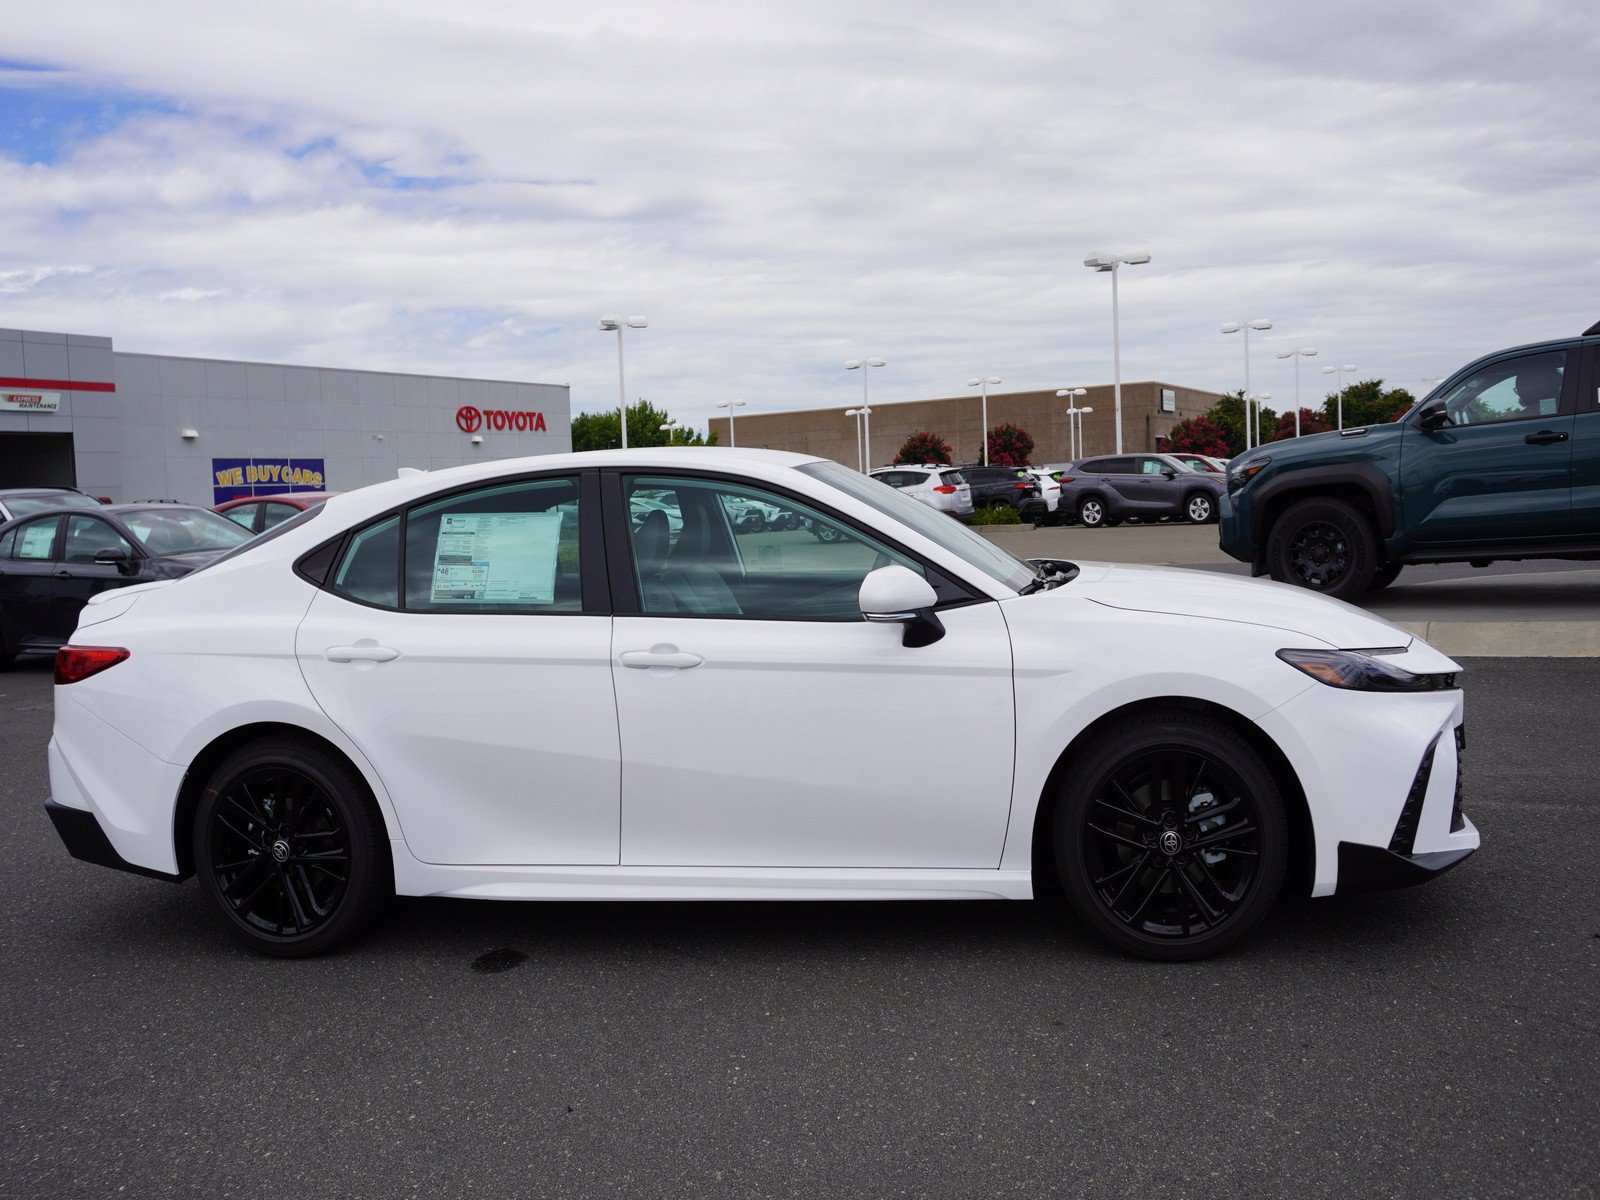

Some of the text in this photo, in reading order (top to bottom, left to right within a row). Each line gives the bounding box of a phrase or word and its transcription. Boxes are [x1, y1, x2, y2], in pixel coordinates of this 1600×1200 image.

[483, 410, 546, 432] TOYOTA
[215, 465, 323, 488] WE BUY CARS
